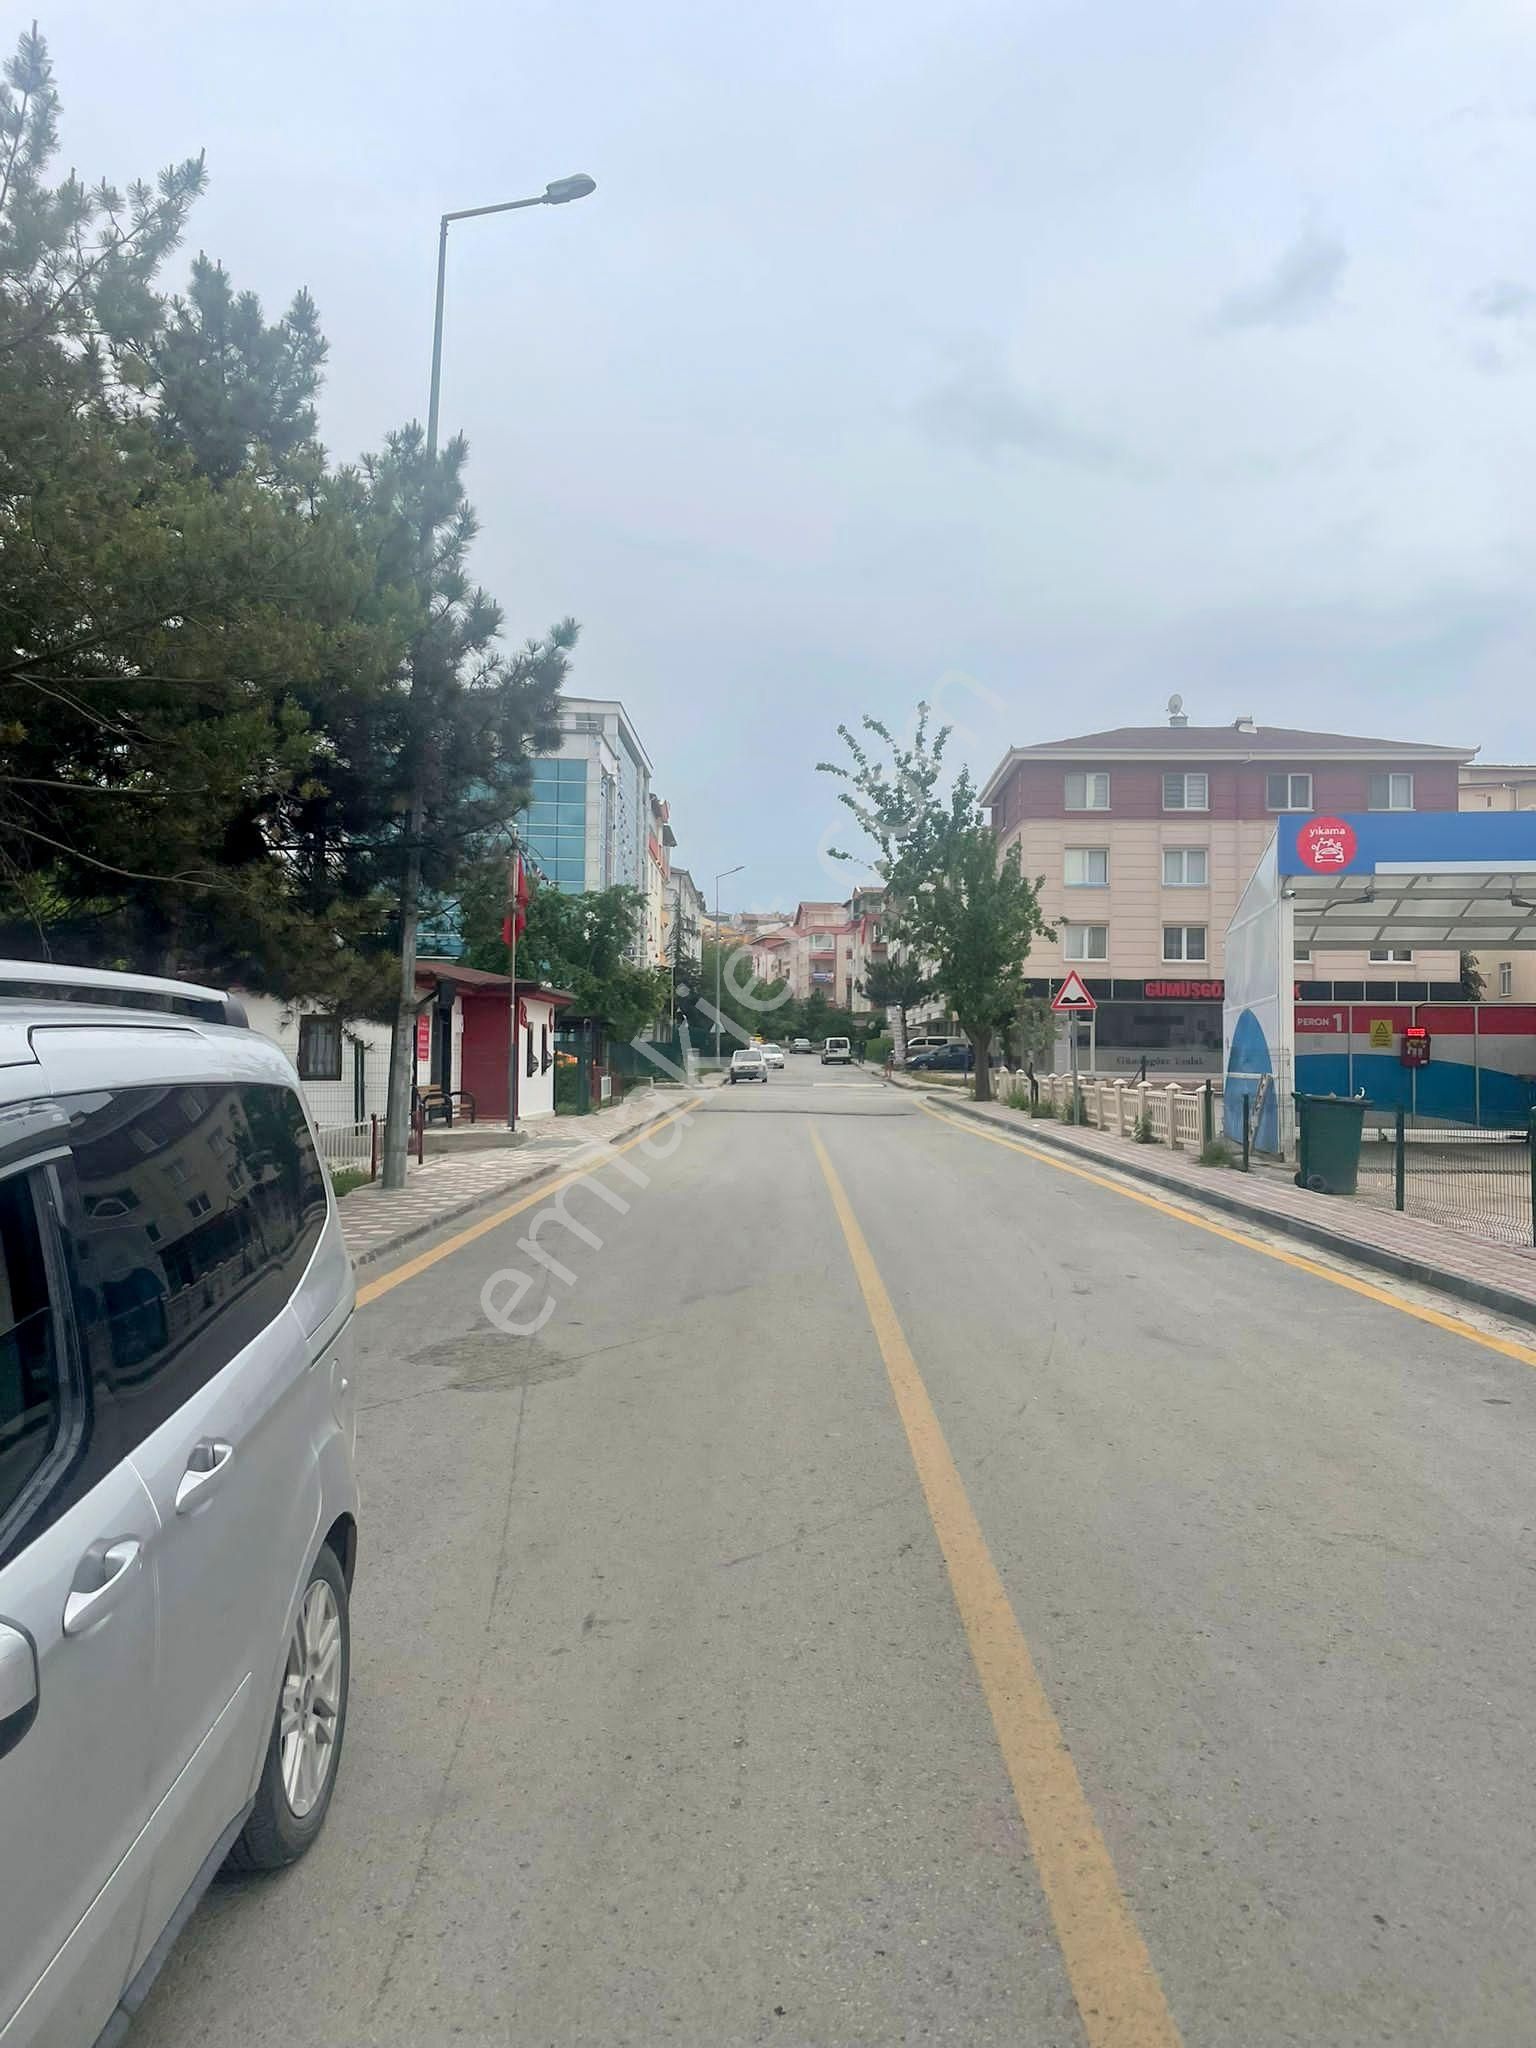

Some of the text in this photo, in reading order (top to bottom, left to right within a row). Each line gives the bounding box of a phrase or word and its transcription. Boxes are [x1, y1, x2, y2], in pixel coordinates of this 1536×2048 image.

[1145, 980, 1222, 999] GÜMÜŞGÖ
[1297, 1012, 1343, 1033] PERON 1
